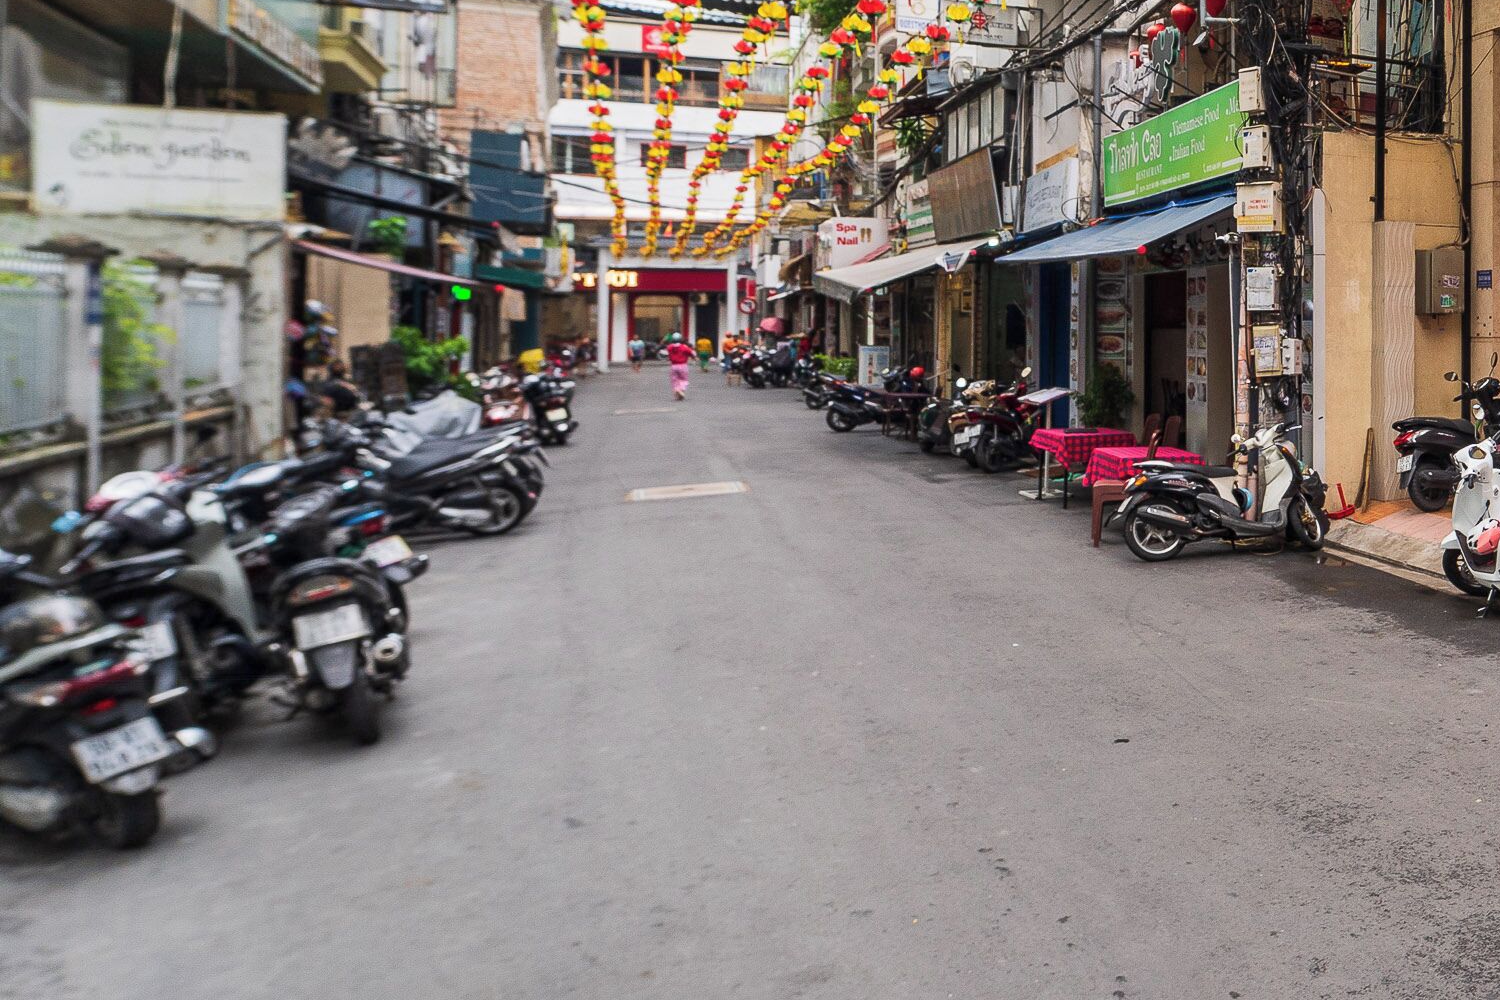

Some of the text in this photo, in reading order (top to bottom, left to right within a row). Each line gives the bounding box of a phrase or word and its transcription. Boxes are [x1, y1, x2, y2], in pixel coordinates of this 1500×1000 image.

[1141, 129, 1162, 163] Cao
[836, 223, 857, 233] Spa
[837, 236, 858, 245] Nail
